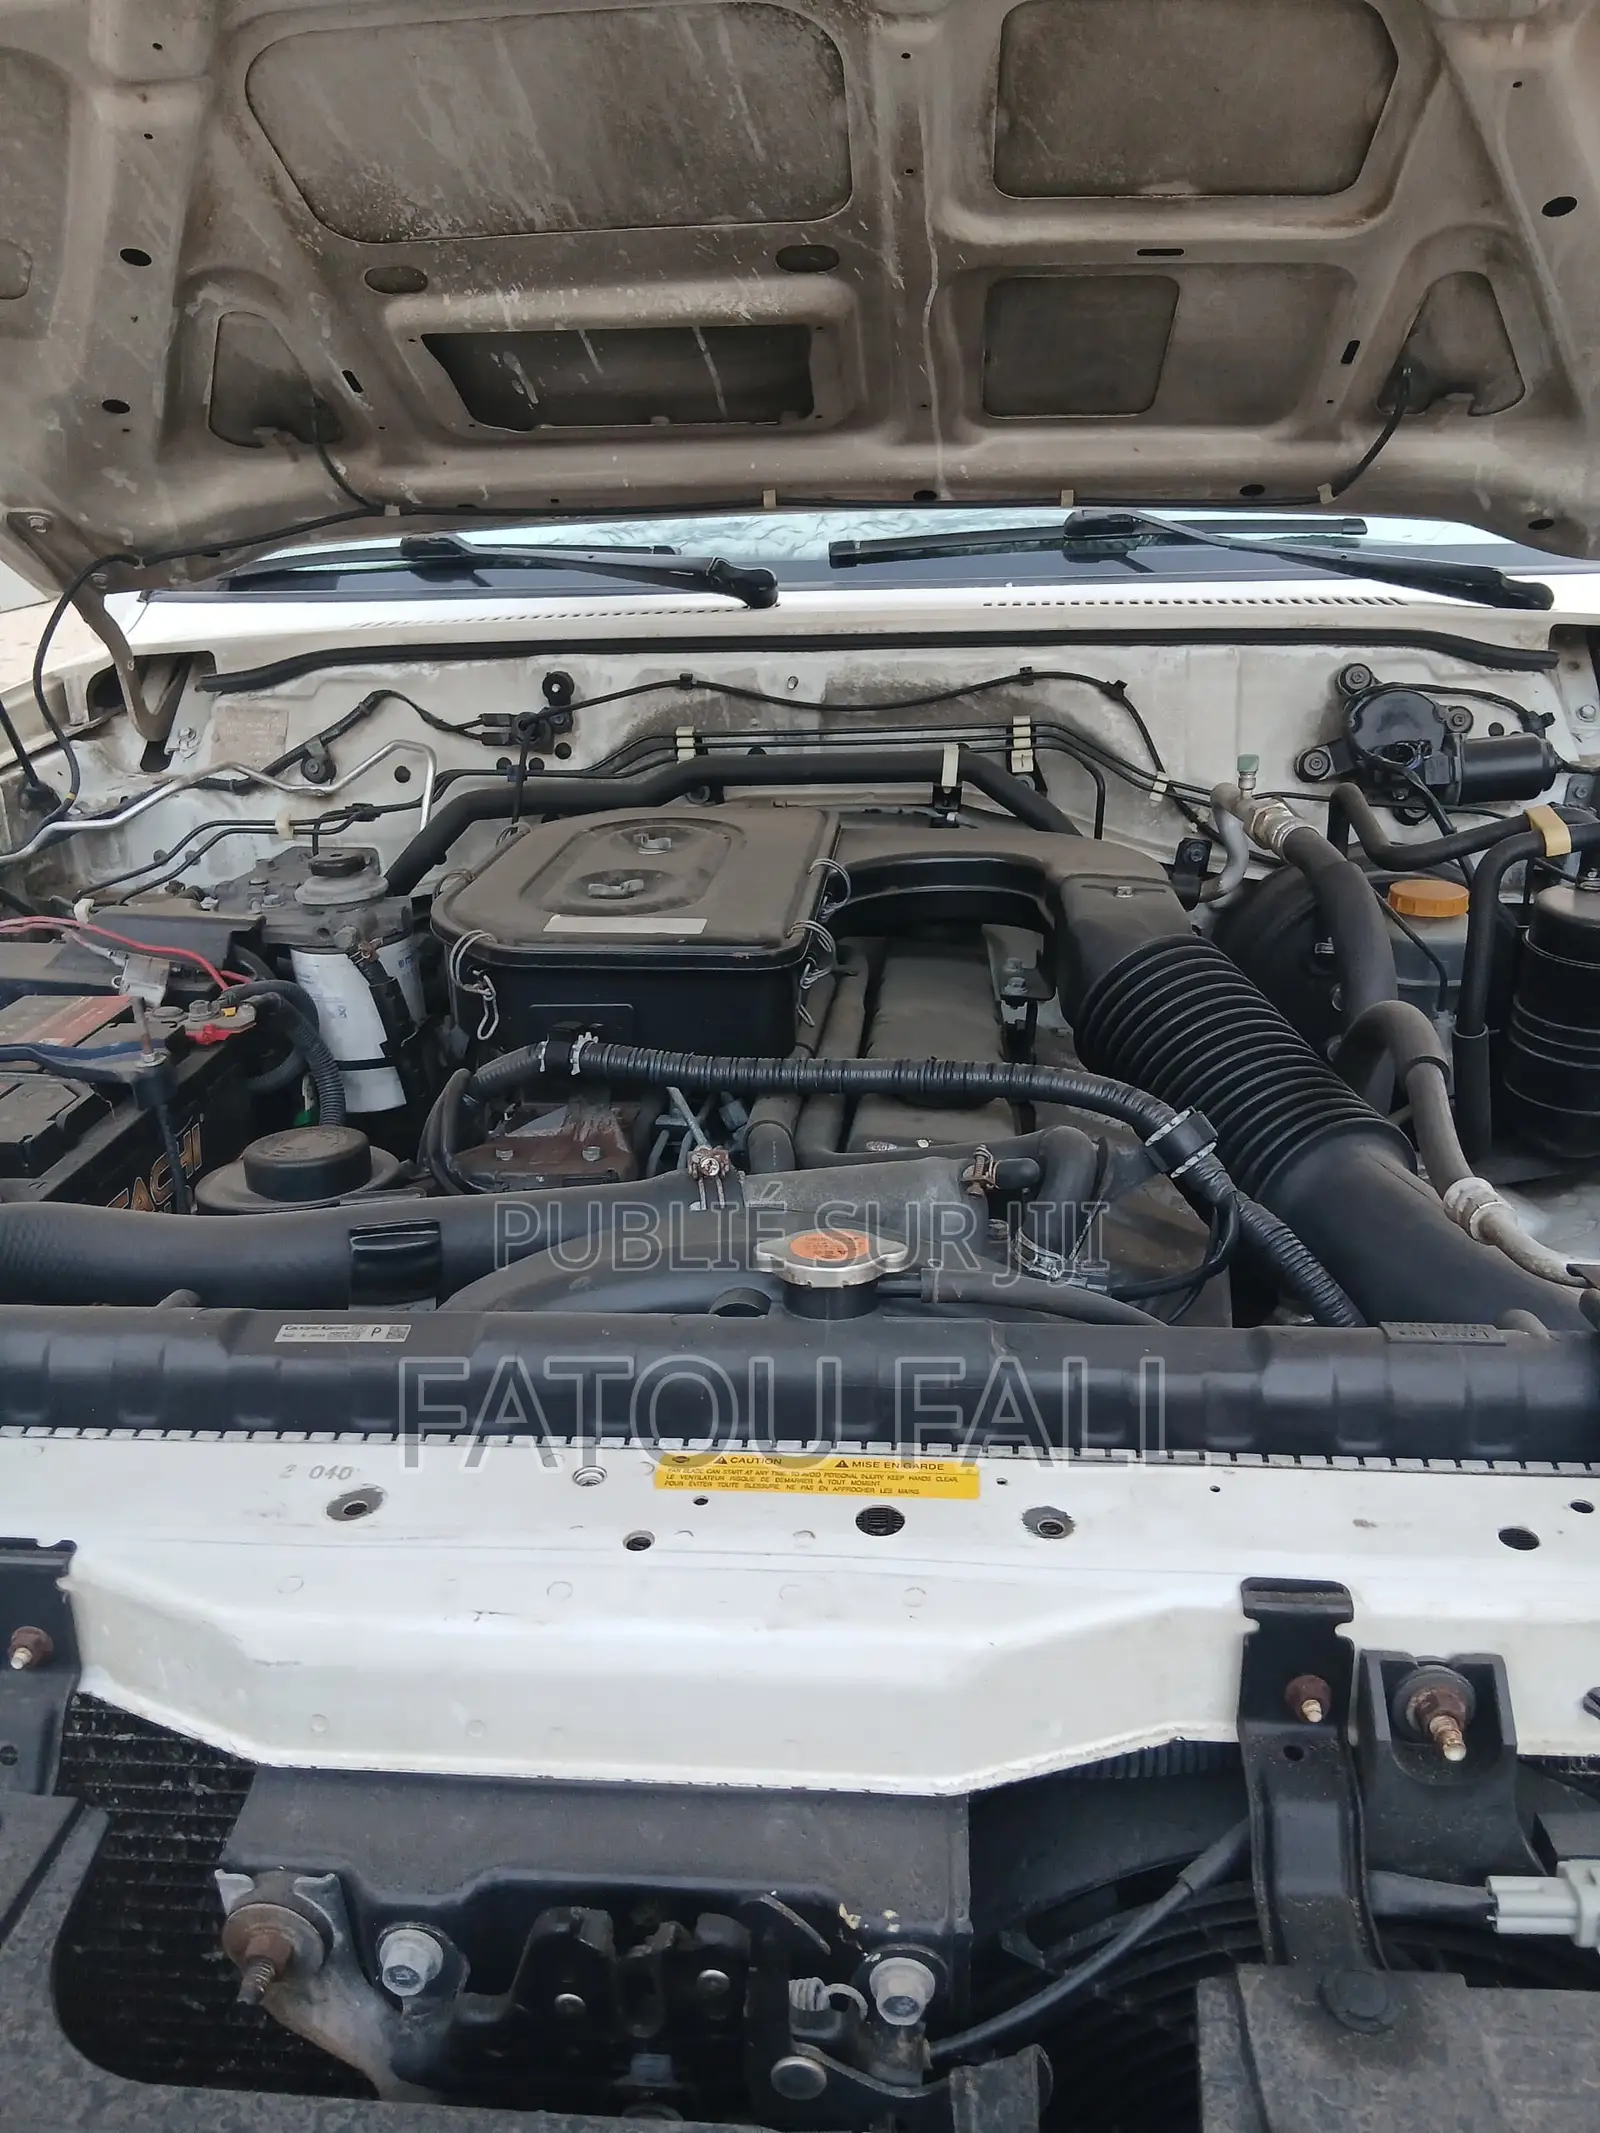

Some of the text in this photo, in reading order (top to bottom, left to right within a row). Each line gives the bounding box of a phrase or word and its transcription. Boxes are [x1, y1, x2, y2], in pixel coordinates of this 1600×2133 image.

[730, 1456, 782, 1465] CAUTION
[852, 1460, 881, 1469] MISE
[903, 1462, 944, 1471] GARDE
[664, 1479, 683, 1487] POUR
[717, 1480, 739, 1488] TOUTE
